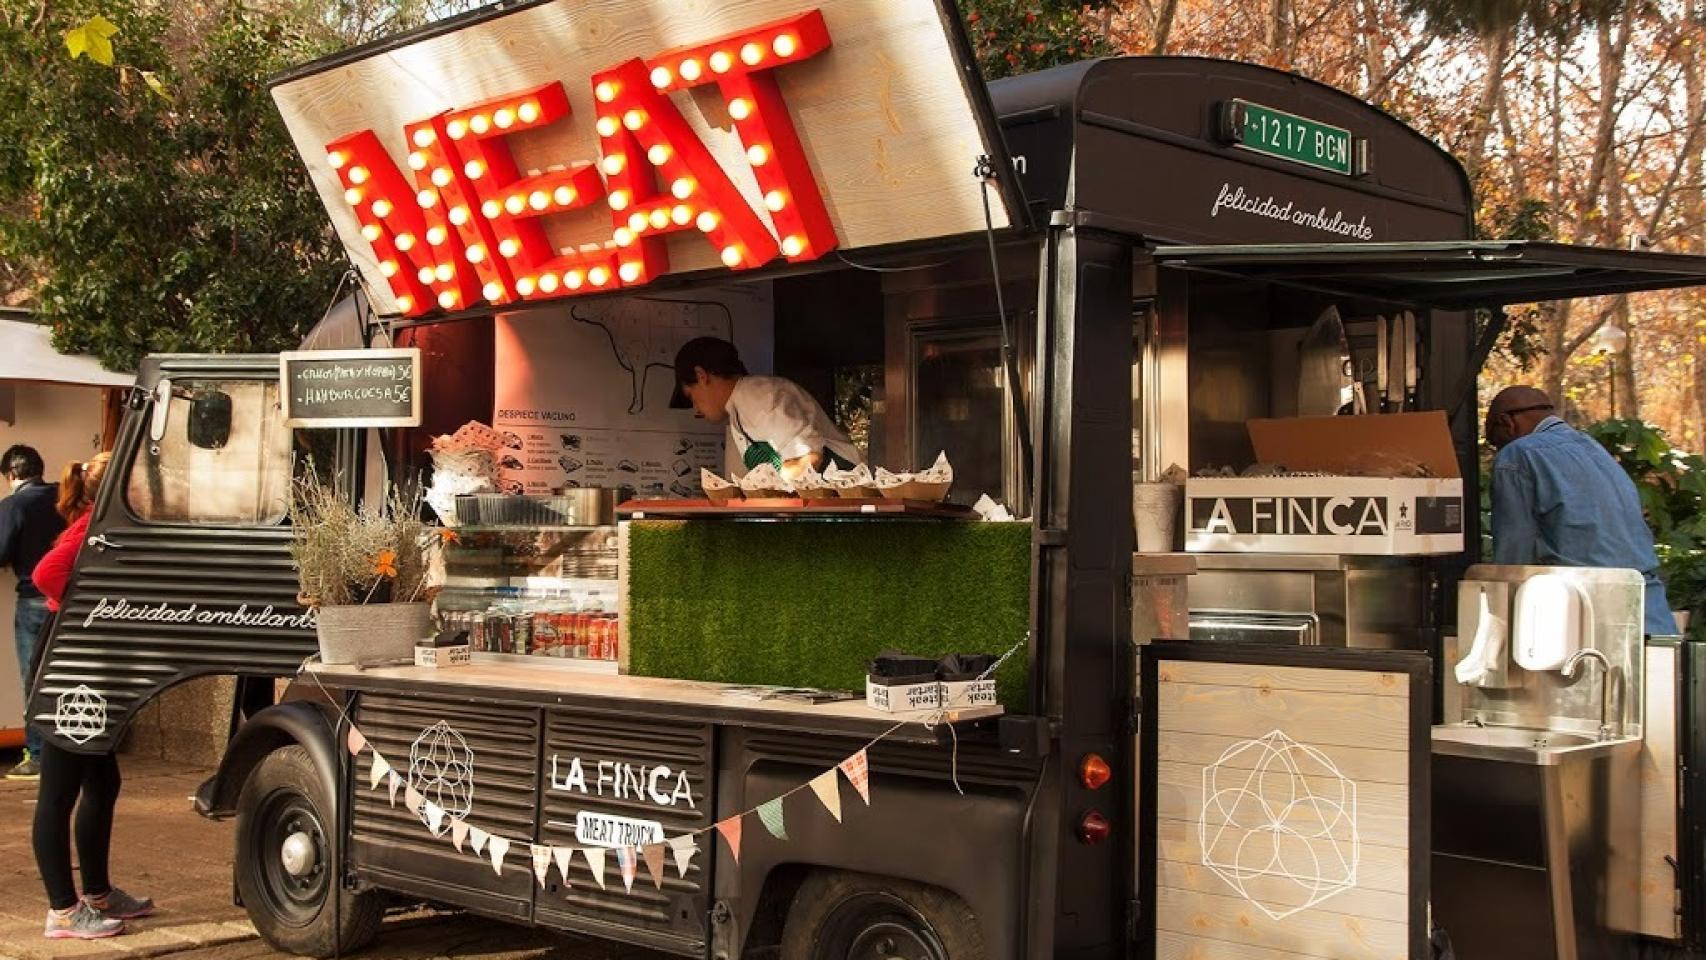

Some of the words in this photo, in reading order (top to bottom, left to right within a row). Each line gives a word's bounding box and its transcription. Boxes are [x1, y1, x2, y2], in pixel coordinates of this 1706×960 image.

[325, 9, 840, 316] MEAT
[1211, 183, 1294, 221] felicidad
[1292, 206, 1373, 240] ambulante
[541, 410, 576, 421] VACUNO
[1187, 497, 1237, 534] LA
[1252, 497, 1389, 535] FINCA
[82, 598, 198, 628] felicidad
[552, 754, 589, 794] LA
[598, 760, 696, 809] FINCA
[582, 816, 614, 842] MEAT
[617, 820, 657, 847] TRUCK
